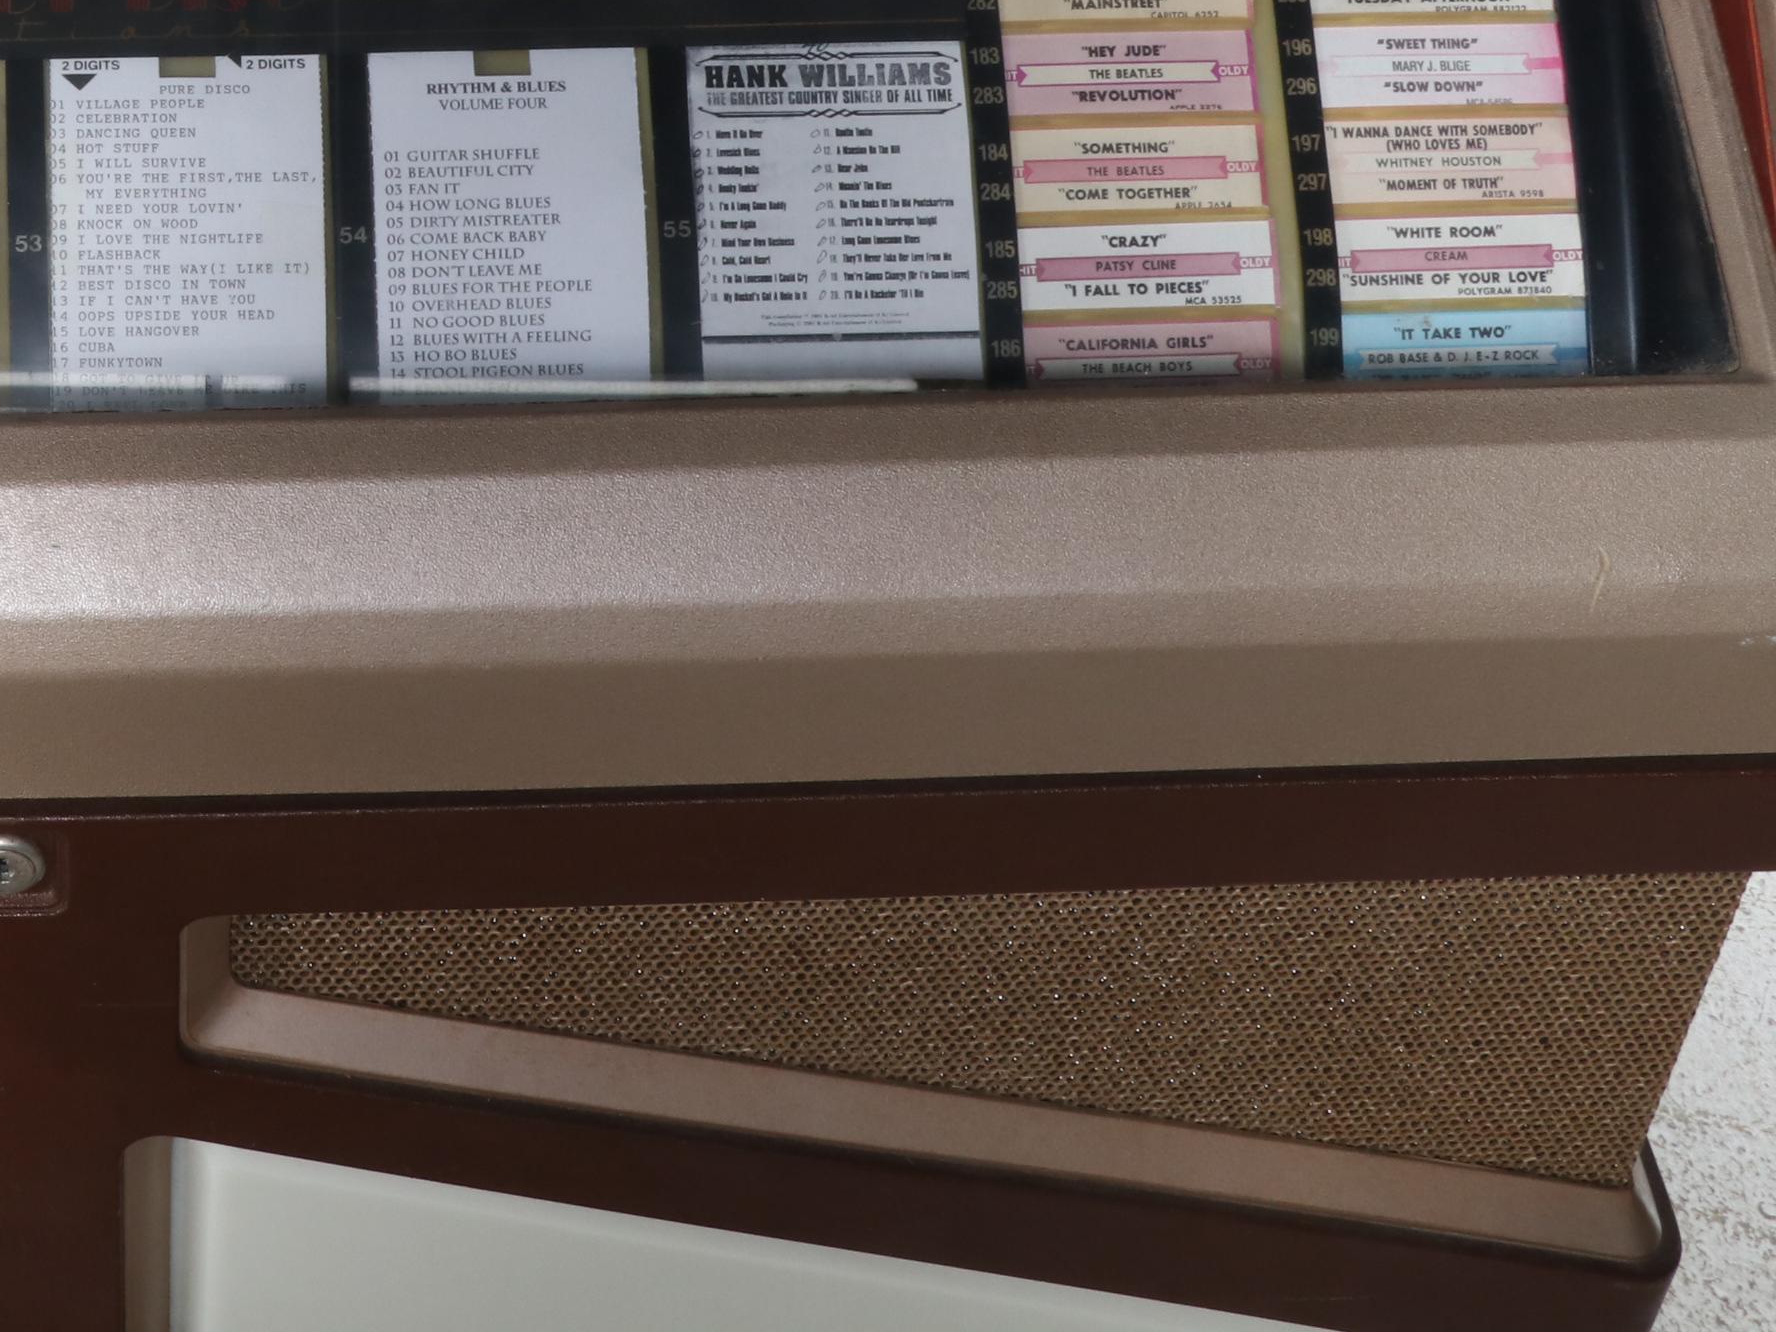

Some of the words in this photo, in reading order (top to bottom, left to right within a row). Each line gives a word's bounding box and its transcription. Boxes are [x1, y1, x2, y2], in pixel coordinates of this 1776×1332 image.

[703, 64, 789, 89] HANK
[797, 61, 952, 88] WILLIAMS
[1088, 69, 1111, 80] THE
[1115, 68, 1164, 79] BEATLES
[159, 84, 195, 95] PURE
[204, 84, 251, 95] DISCO
[426, 81, 496, 95] RHYTHM
[500, 81, 513, 93] &
[516, 80, 567, 93] BLUES
[75, 99, 140, 110] VILLAGE
[150, 98, 205, 109] PEOPLE
[438, 97, 504, 111] VOLUME
[507, 97, 548, 110] FOUR
[729, 91, 784, 106] GREATEST
[787, 90, 839, 105] COUNTRY
[842, 89, 883, 105] SINGER
[886, 89, 900, 103] OF
[904, 88, 923, 103] ALL
[926, 88, 953, 103] TIME
[76, 127, 141, 140] DANCING
[149, 127, 196, 140] QUEEN
[978, 143, 1009, 161] 184
[1375, 156, 1433, 168] WHITNEY
[1441, 155, 1503, 168] HOUSTON
[663, 220, 692, 238] 55
